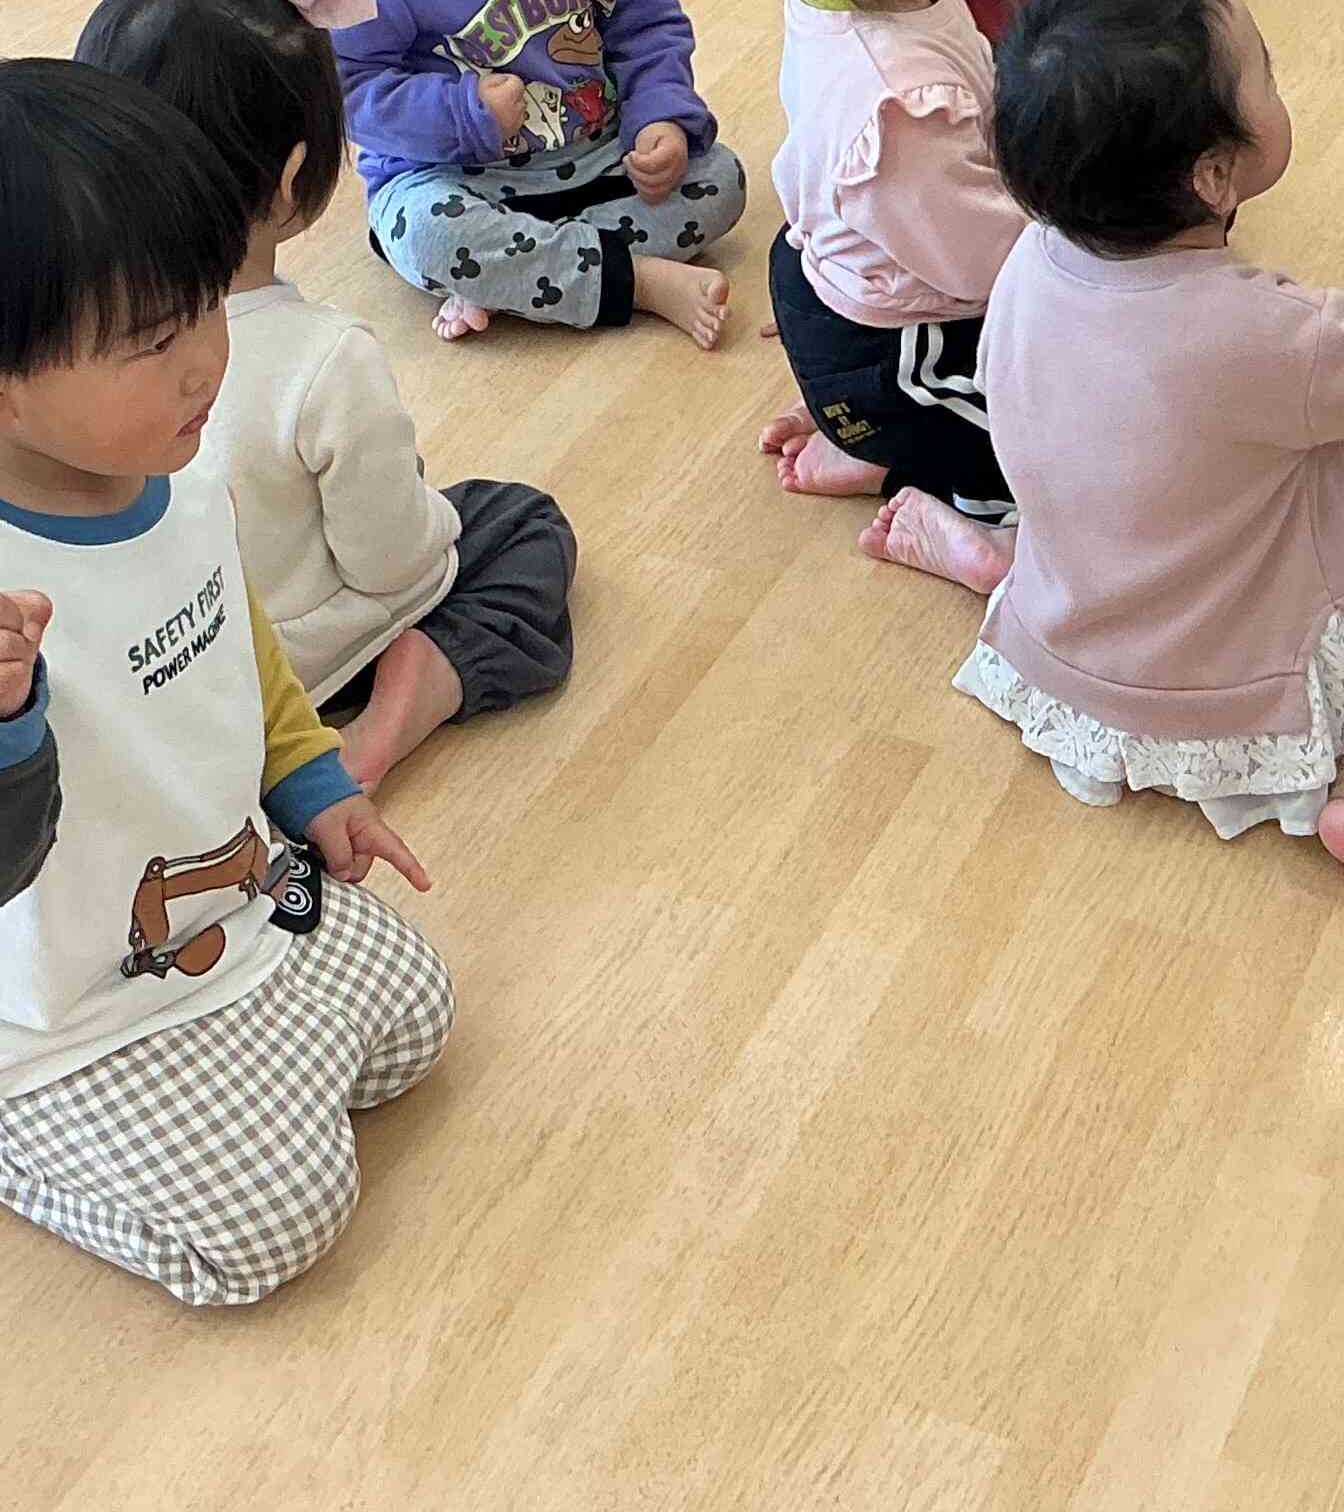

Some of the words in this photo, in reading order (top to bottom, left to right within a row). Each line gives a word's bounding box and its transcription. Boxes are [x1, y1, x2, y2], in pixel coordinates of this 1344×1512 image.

[128, 602, 197, 674] SAFETY
[197, 565, 226, 619] FIRST
[143, 649, 192, 696] POWER
